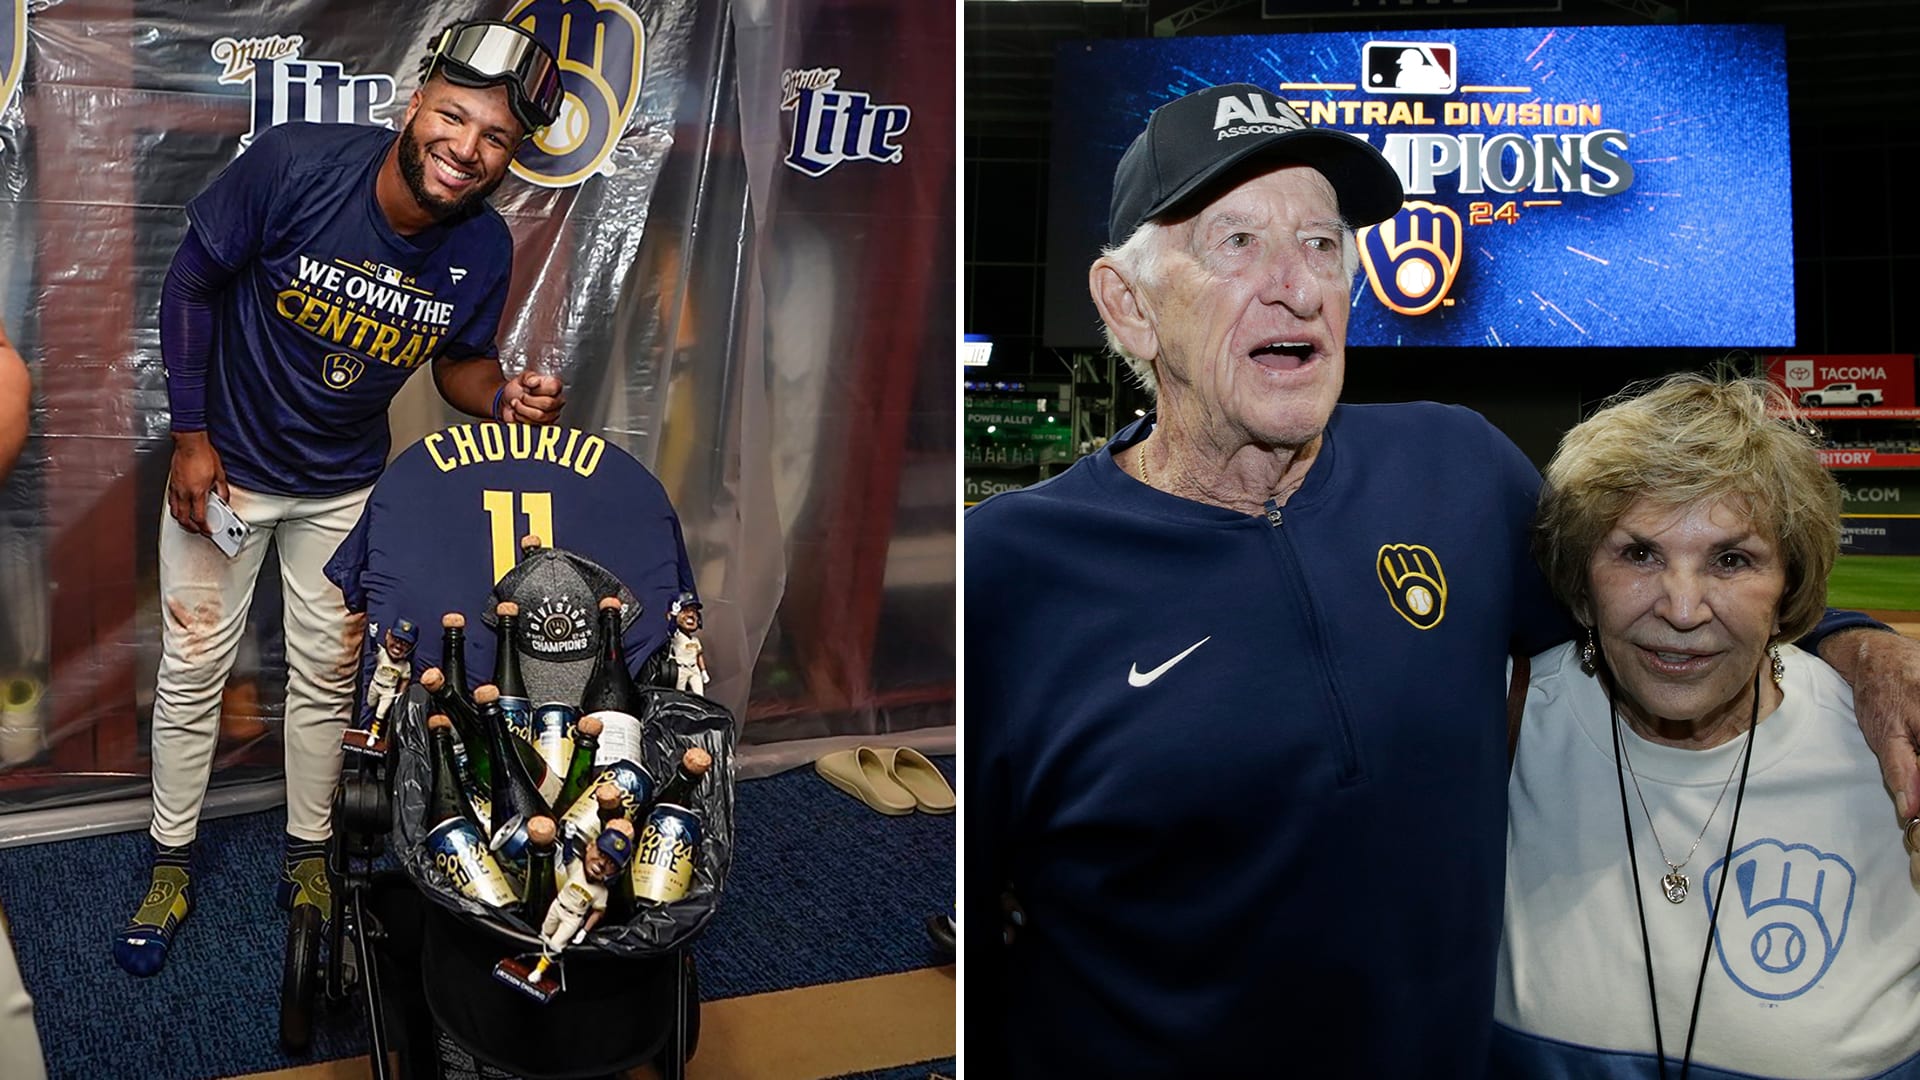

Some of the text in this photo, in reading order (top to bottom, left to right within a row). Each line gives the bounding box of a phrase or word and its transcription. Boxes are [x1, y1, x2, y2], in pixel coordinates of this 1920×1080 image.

[214, 36, 300, 81] Miller
[781, 69, 837, 107] Miller
[1444, 101, 1601, 126] DIVISION
[787, 88, 908, 173] Lite
[1468, 201, 1520, 225] 24
[299, 255, 455, 326] WE OWN THE
[290, 278, 449, 336] NATIONAL LEAGUE
[1819, 366, 1888, 381] TACOMA
[967, 413, 1034, 425] POWER ALLEY
[424, 422, 607, 478] CHOURIO
[1817, 452, 1872, 465] RITORY
[483, 490, 554, 587] 11
[530, 602, 586, 632] DIVISION
[531, 637, 588, 653] CHAMPIONS
[639, 846, 679, 875] EDGE
